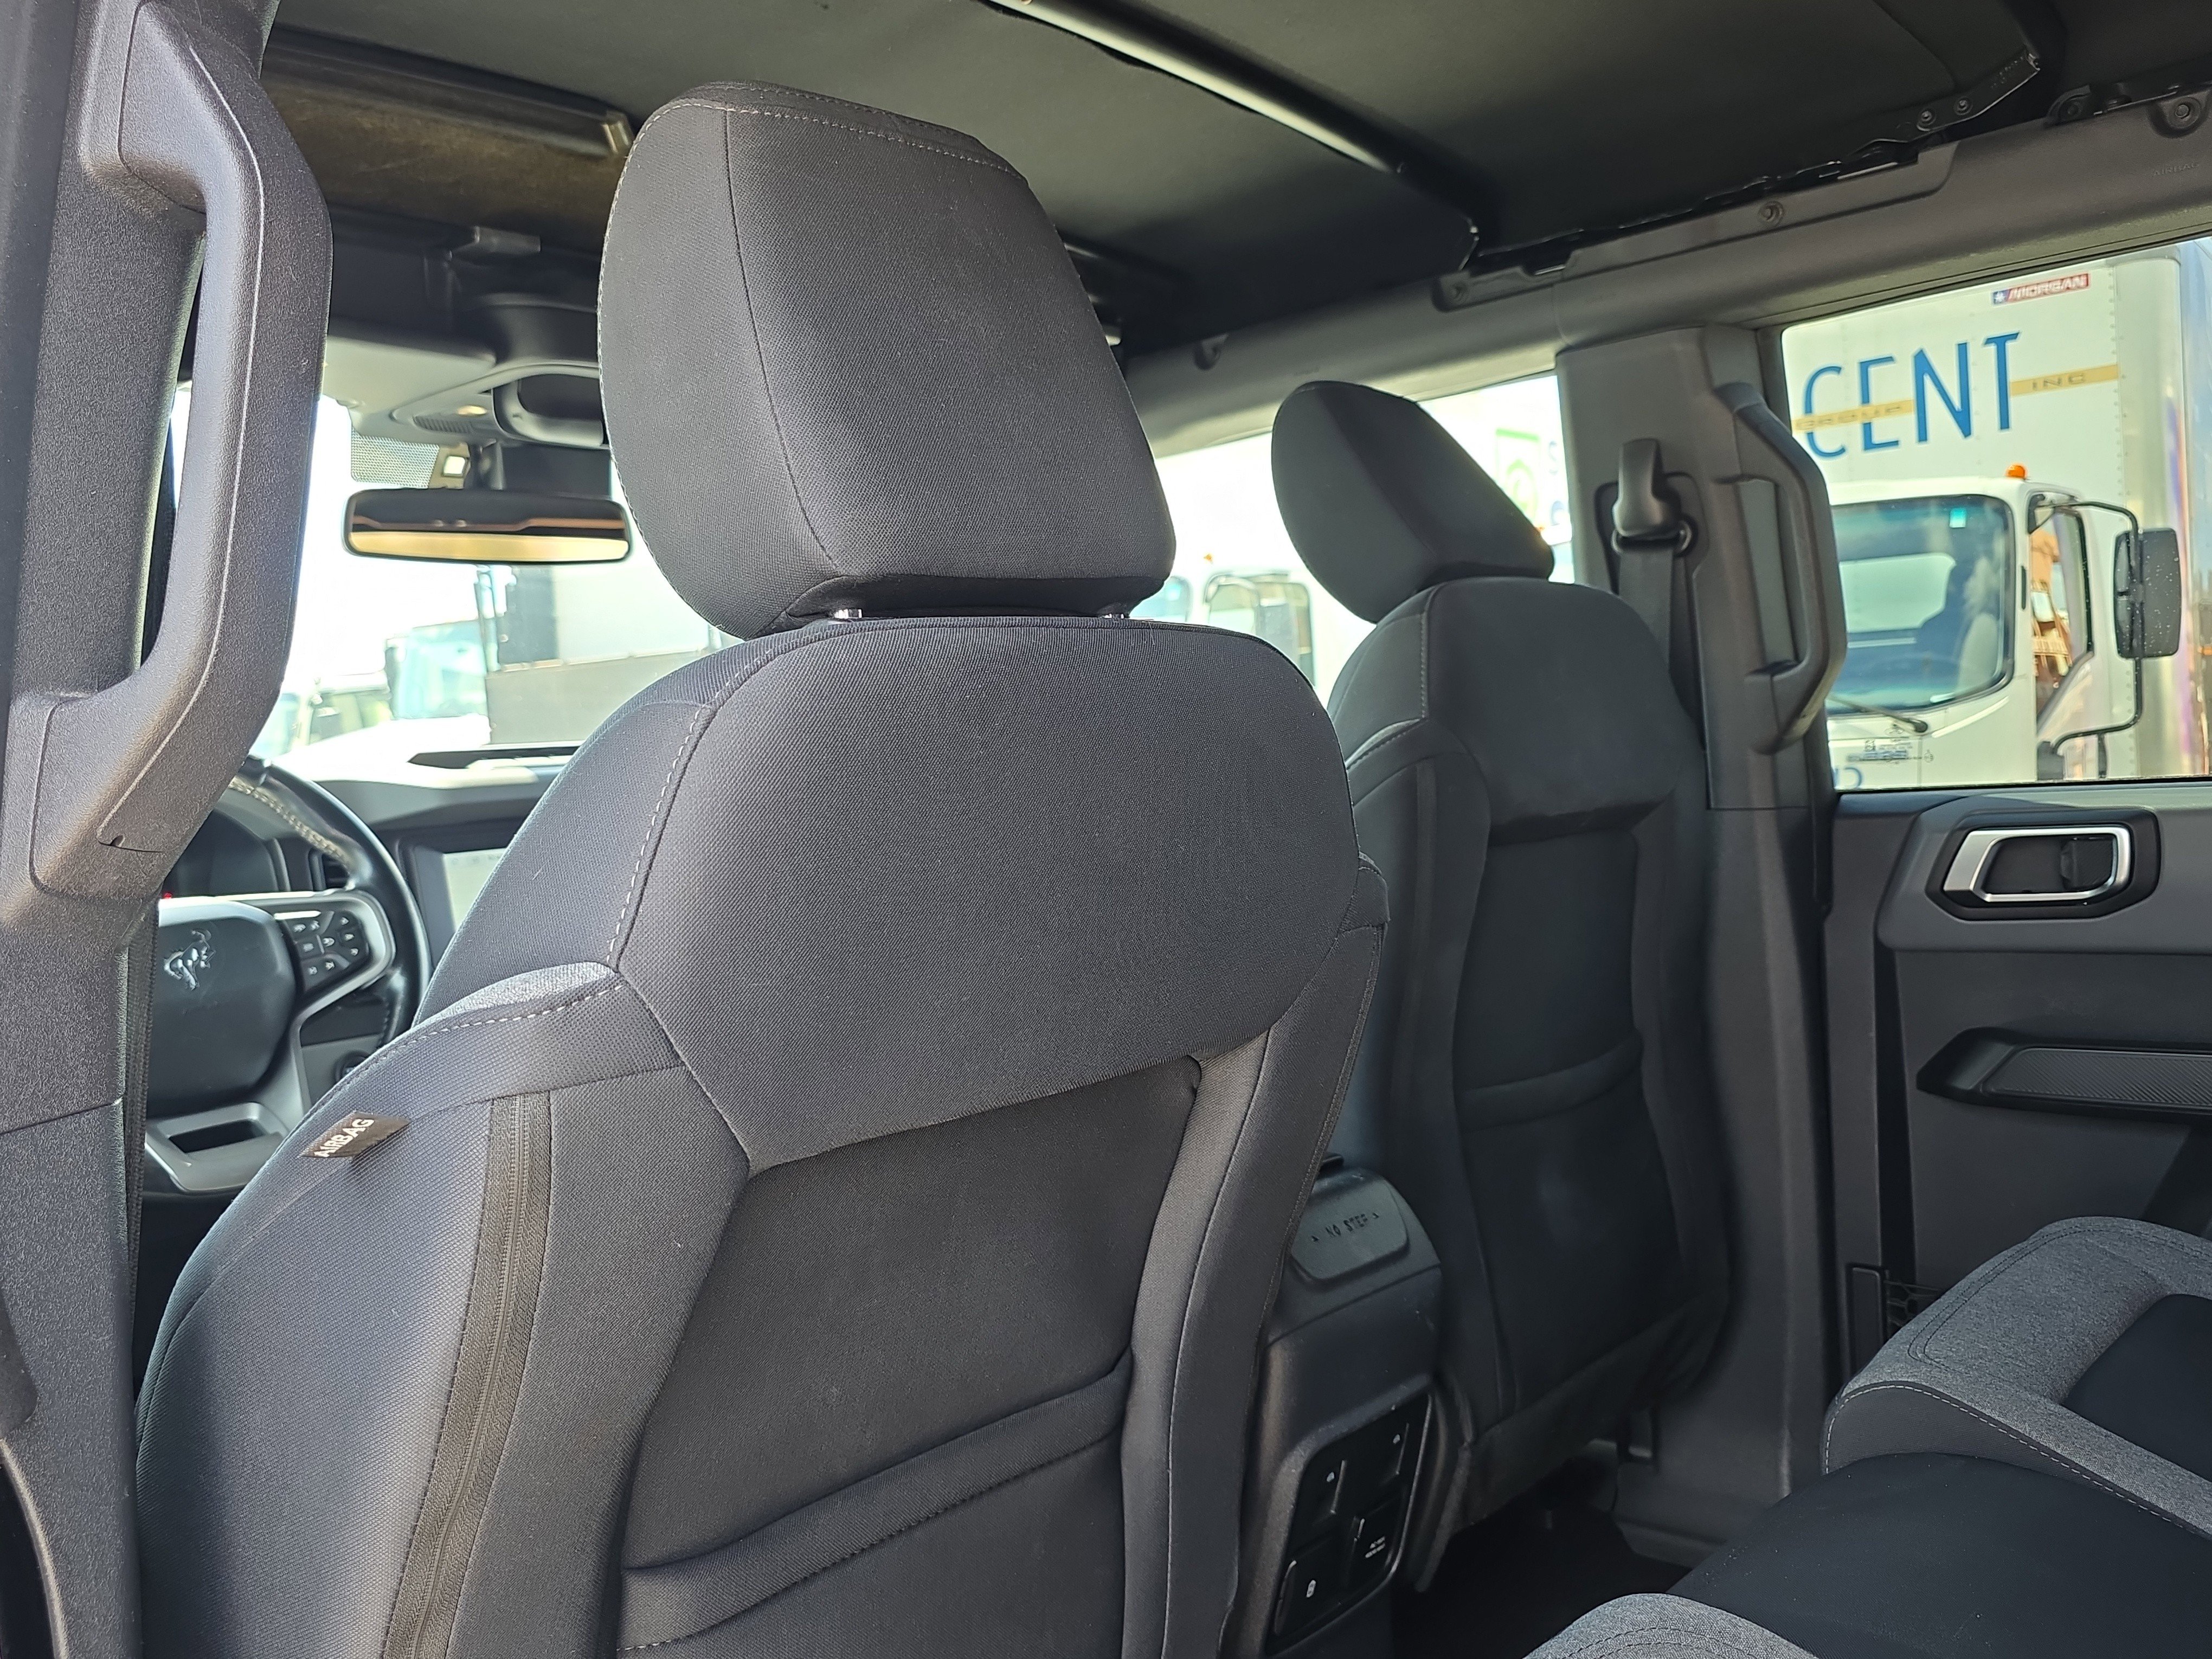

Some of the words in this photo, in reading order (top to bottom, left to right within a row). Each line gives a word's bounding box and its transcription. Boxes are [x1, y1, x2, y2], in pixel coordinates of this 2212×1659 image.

[2153, 162, 2200, 176] AIRBAG
[2007, 274, 2087, 302] MORGAN
[2032, 372, 2085, 391] INC
[1804, 332, 2021, 458] CENT
[314, 1118, 375, 1158] AIRBAG
[1324, 1224, 1341, 1237] NO
